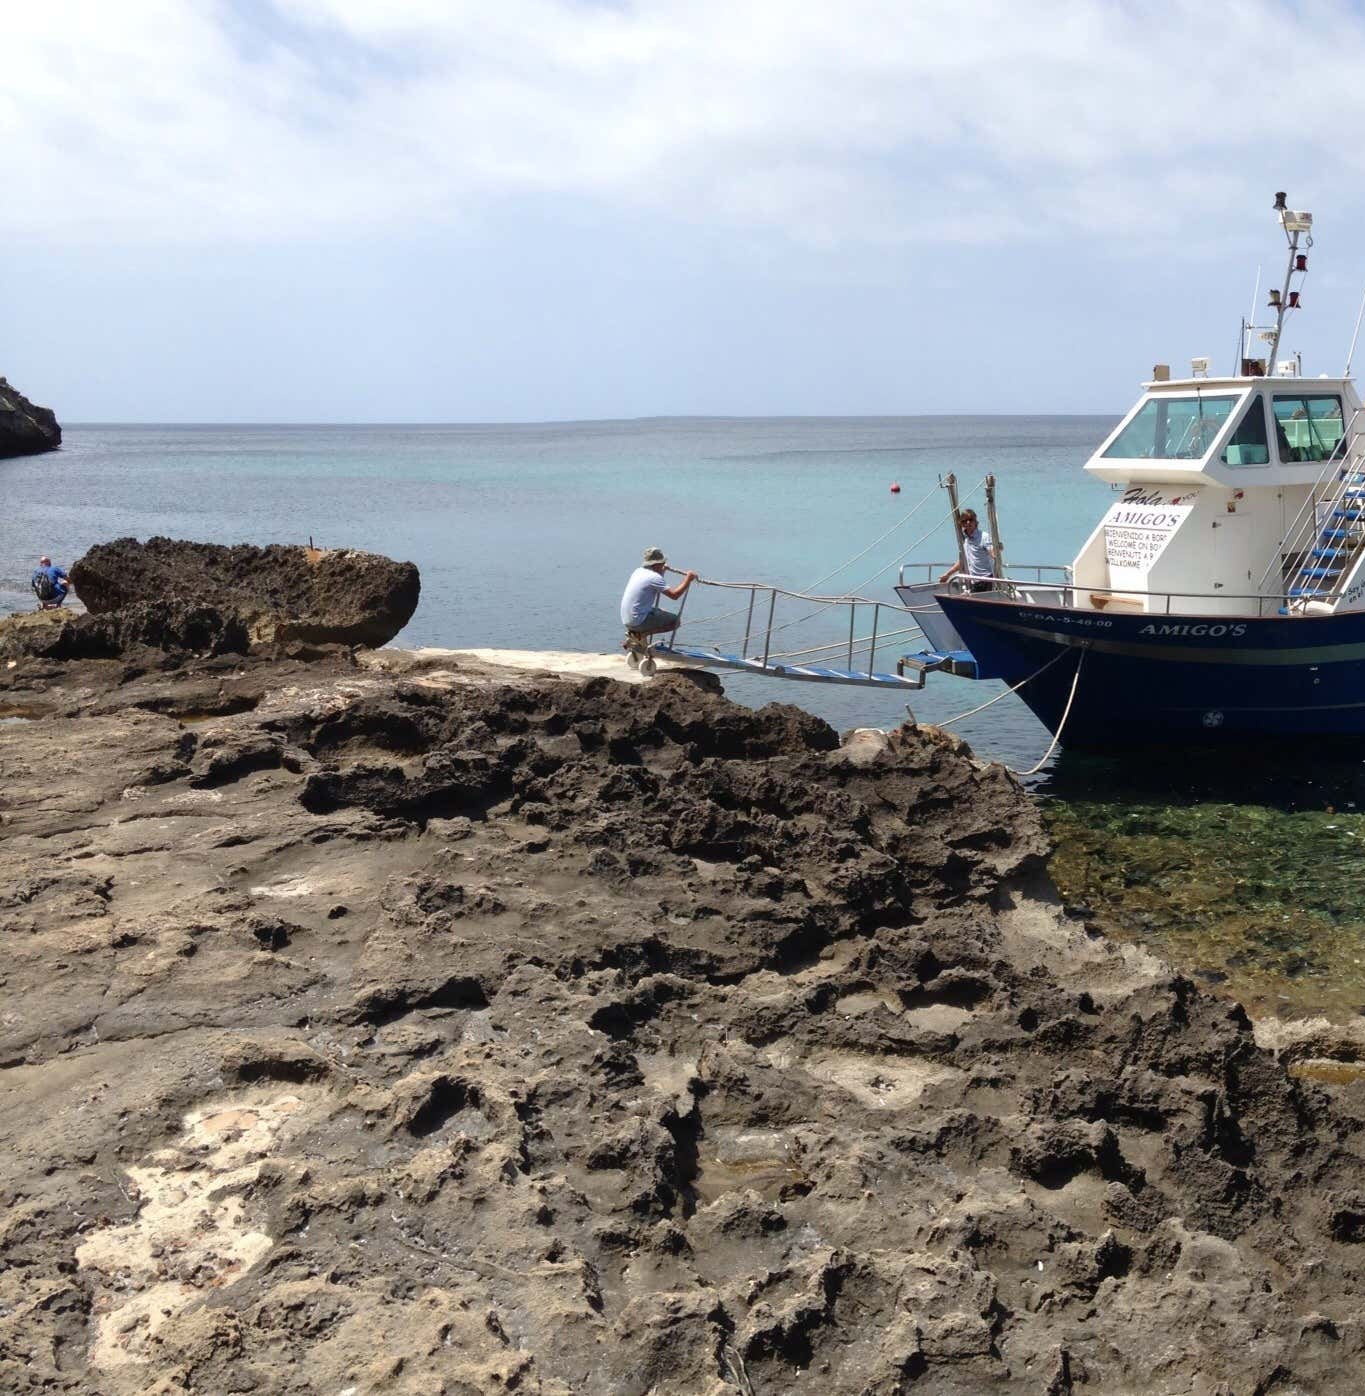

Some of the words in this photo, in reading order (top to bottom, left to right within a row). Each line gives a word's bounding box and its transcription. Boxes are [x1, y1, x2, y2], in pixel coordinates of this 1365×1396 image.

[1109, 512, 1181, 527] AMIGO'S
[1108, 540, 1137, 550] WELCOME
[1139, 623, 1248, 637] AMIGO'S
